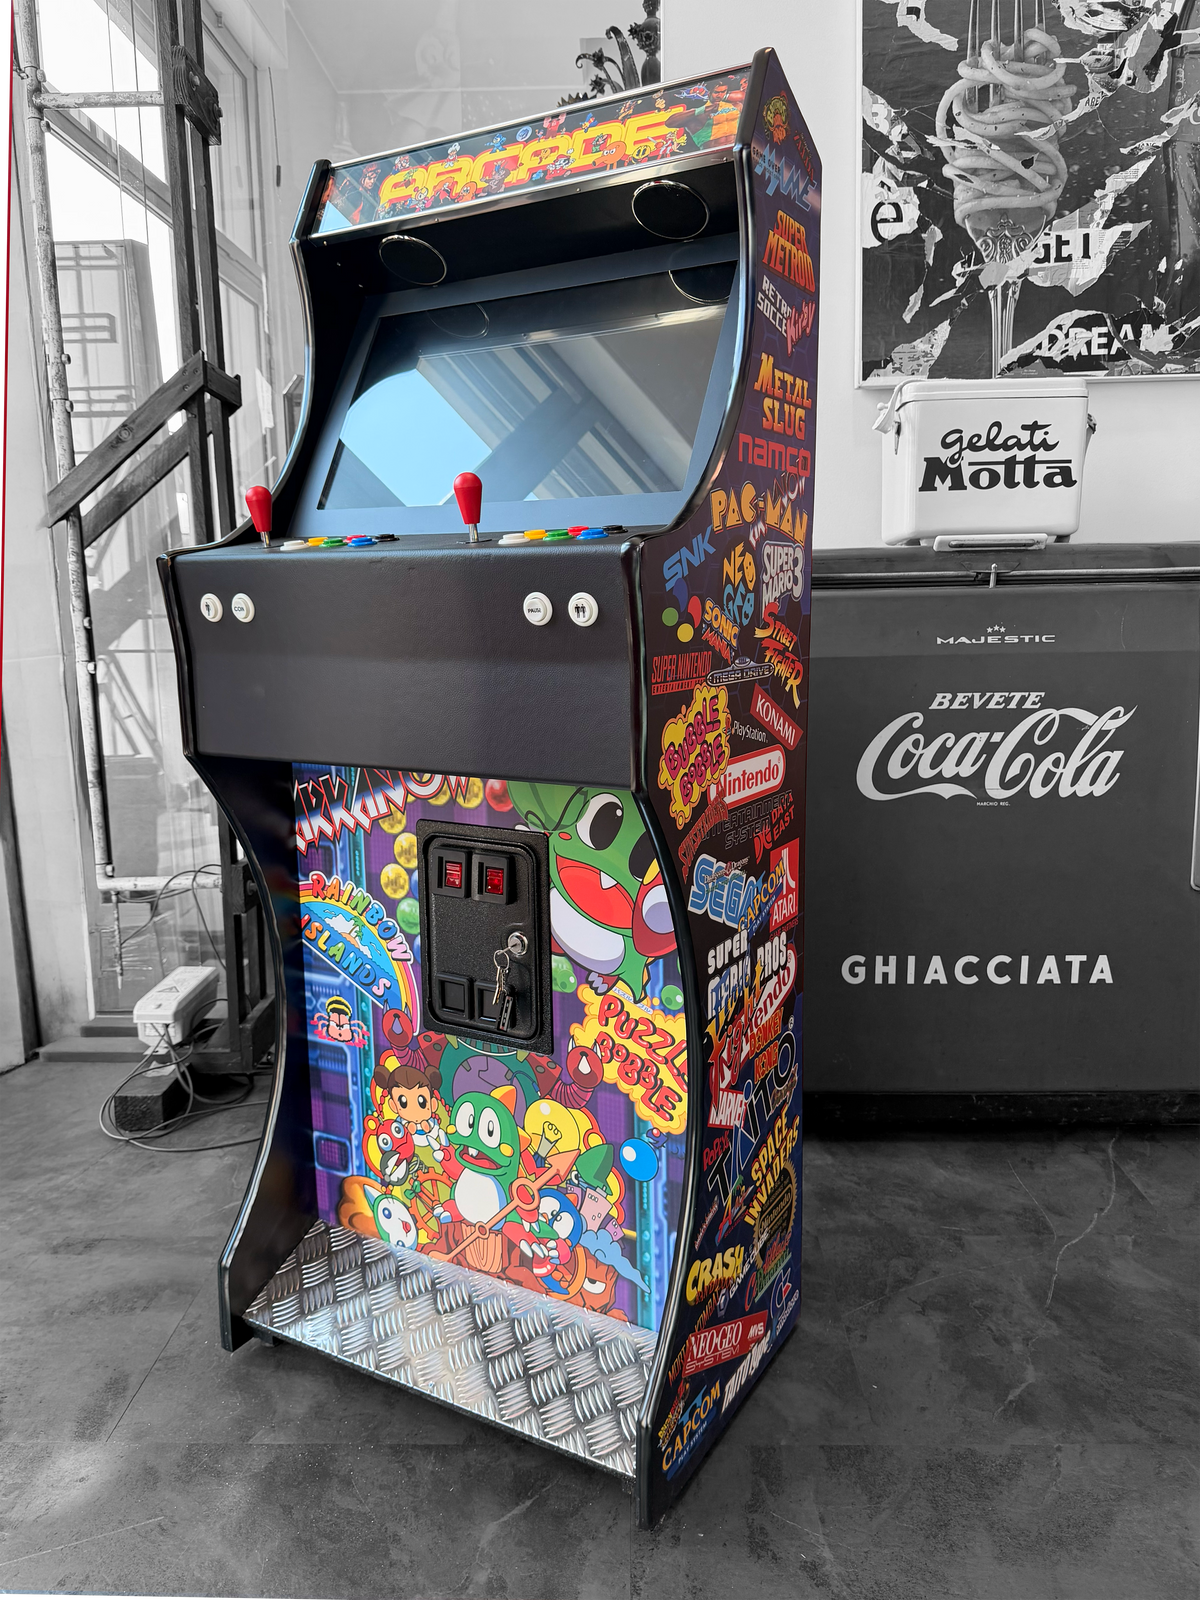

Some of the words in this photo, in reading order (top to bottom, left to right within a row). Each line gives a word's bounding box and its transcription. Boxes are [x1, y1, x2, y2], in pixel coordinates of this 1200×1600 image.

[379, 104, 688, 211] ARCADE
[774, 209, 806, 255] SUPER
[762, 229, 816, 293] METROID
[757, 291, 788, 338] SOCCE
[753, 352, 812, 409] METAL
[762, 397, 806, 441] SLUG
[941, 420, 1060, 460] gelati
[738, 433, 811, 478] namco
[918, 454, 1078, 492] Motta
[710, 482, 808, 548] PAC-MAN
[663, 525, 716, 592] SNK
[723, 541, 756, 591] NEO
[763, 545, 794, 583] SUPER
[792, 546, 804, 598] 3
[762, 569, 793, 619] MARIO
[702, 628, 731, 665] MANIA
[704, 599, 740, 650] SONIC
[754, 602, 798, 652] STREET
[937, 634, 1056, 645] MAJESTIC
[651, 655, 677, 684] SUPER
[677, 651, 712, 679] NINTENDO
[713, 671, 742, 684] MEGA
[743, 665, 770, 678] DRIVE
[760, 638, 804, 710] FIGHTER
[756, 693, 797, 747] KONAMI
[928, 691, 1046, 710] BEVETE
[664, 697, 721, 781] BUBBLE
[856, 704, 1138, 801] Coca-Cola
[679, 732, 726, 807] BOBBLE
[715, 758, 780, 800] Nintendo
[772, 805, 795, 842] EAST
[688, 854, 757, 930] SEGA
[738, 860, 785, 933] CAPCOM
[772, 891, 796, 927] ATARI
[309, 872, 412, 964] RAINBOW
[707, 929, 748, 975] SUPER
[841, 954, 1114, 985] GHIACCIATA
[598, 994, 688, 1093] PUZZL
[749, 1006, 783, 1059] DONKEY
[596, 1031, 682, 1121] BOBBLE
[754, 1040, 779, 1085] KONG
[751, 1101, 788, 1187] SPACE
[686, 1244, 745, 1306] CRASH
[747, 1322, 765, 1340] MVS
[684, 1344, 741, 1375] SYSTEM
[662, 1379, 721, 1471] CAPCOM
